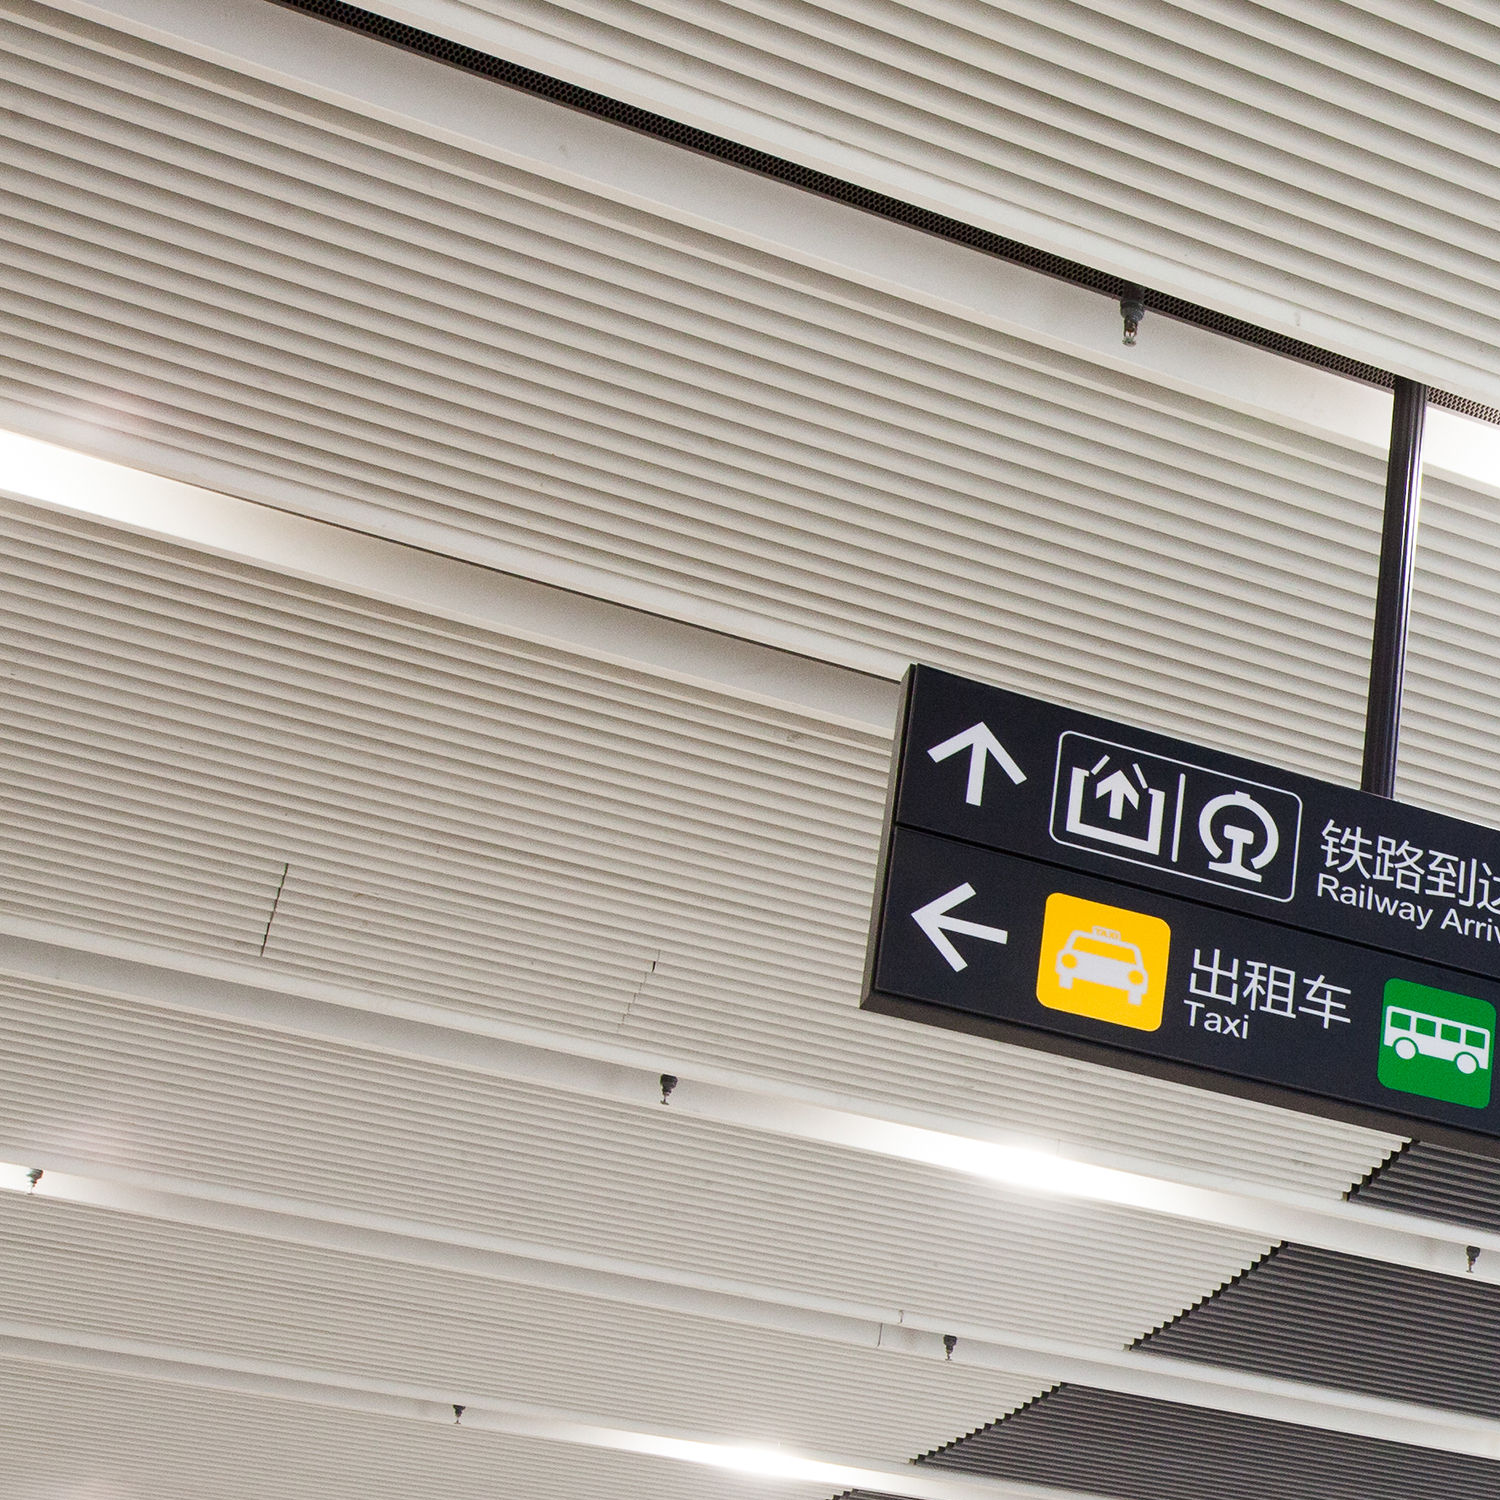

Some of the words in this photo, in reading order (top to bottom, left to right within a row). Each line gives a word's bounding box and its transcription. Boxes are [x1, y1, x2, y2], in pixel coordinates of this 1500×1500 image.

[1317, 872, 1434, 930] Railway
[1188, 947, 1352, 1030] 出租车
[1184, 1001, 1250, 1040] Taxi
